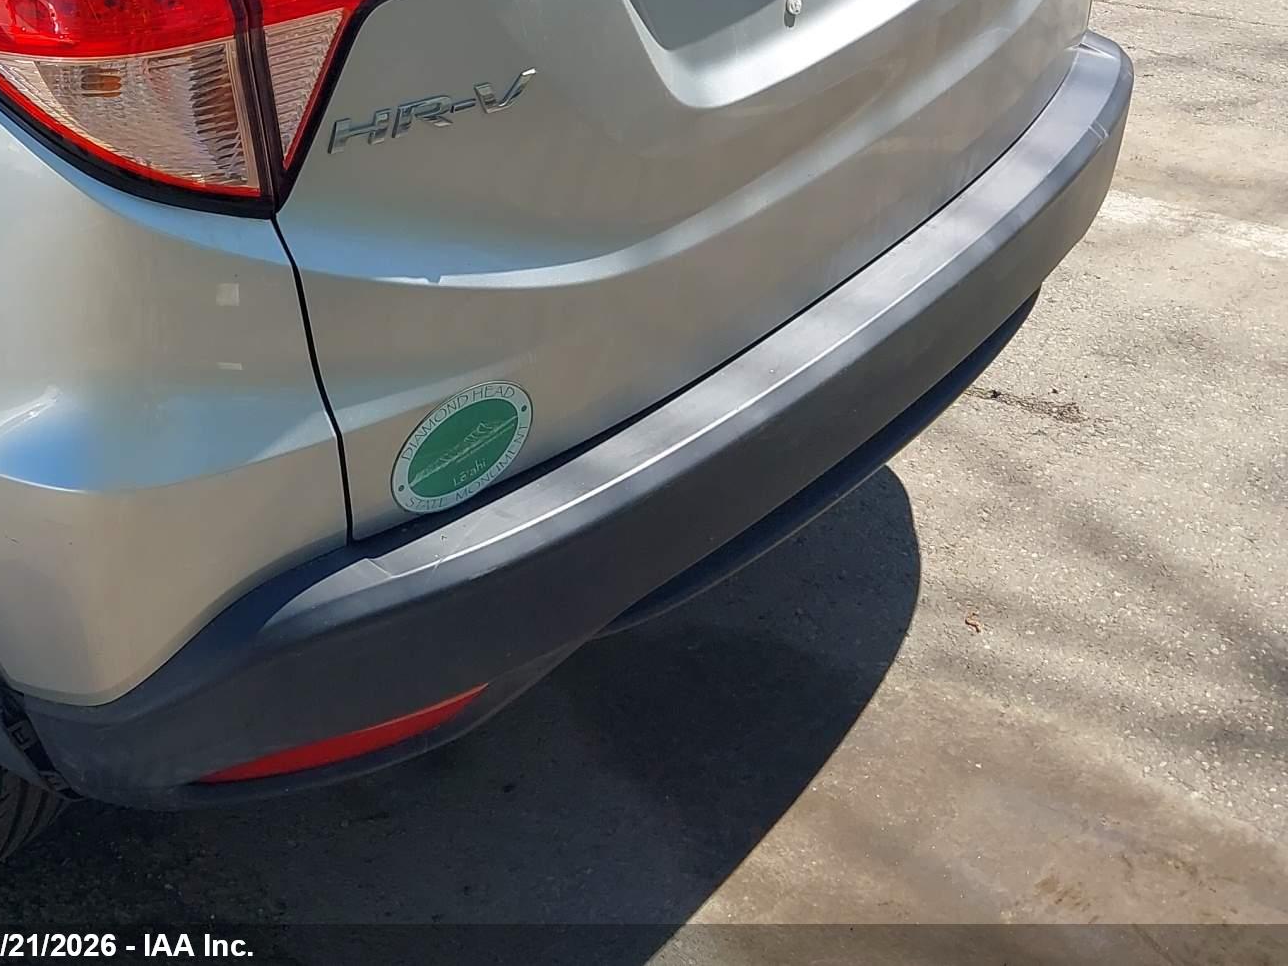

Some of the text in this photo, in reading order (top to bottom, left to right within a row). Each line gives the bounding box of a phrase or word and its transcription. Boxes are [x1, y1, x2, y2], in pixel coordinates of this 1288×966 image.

[327, 67, 537, 155] HR-V
[401, 385, 515, 462] DIAMOND HEAD
[405, 426, 529, 510] STATE MONUMENT
